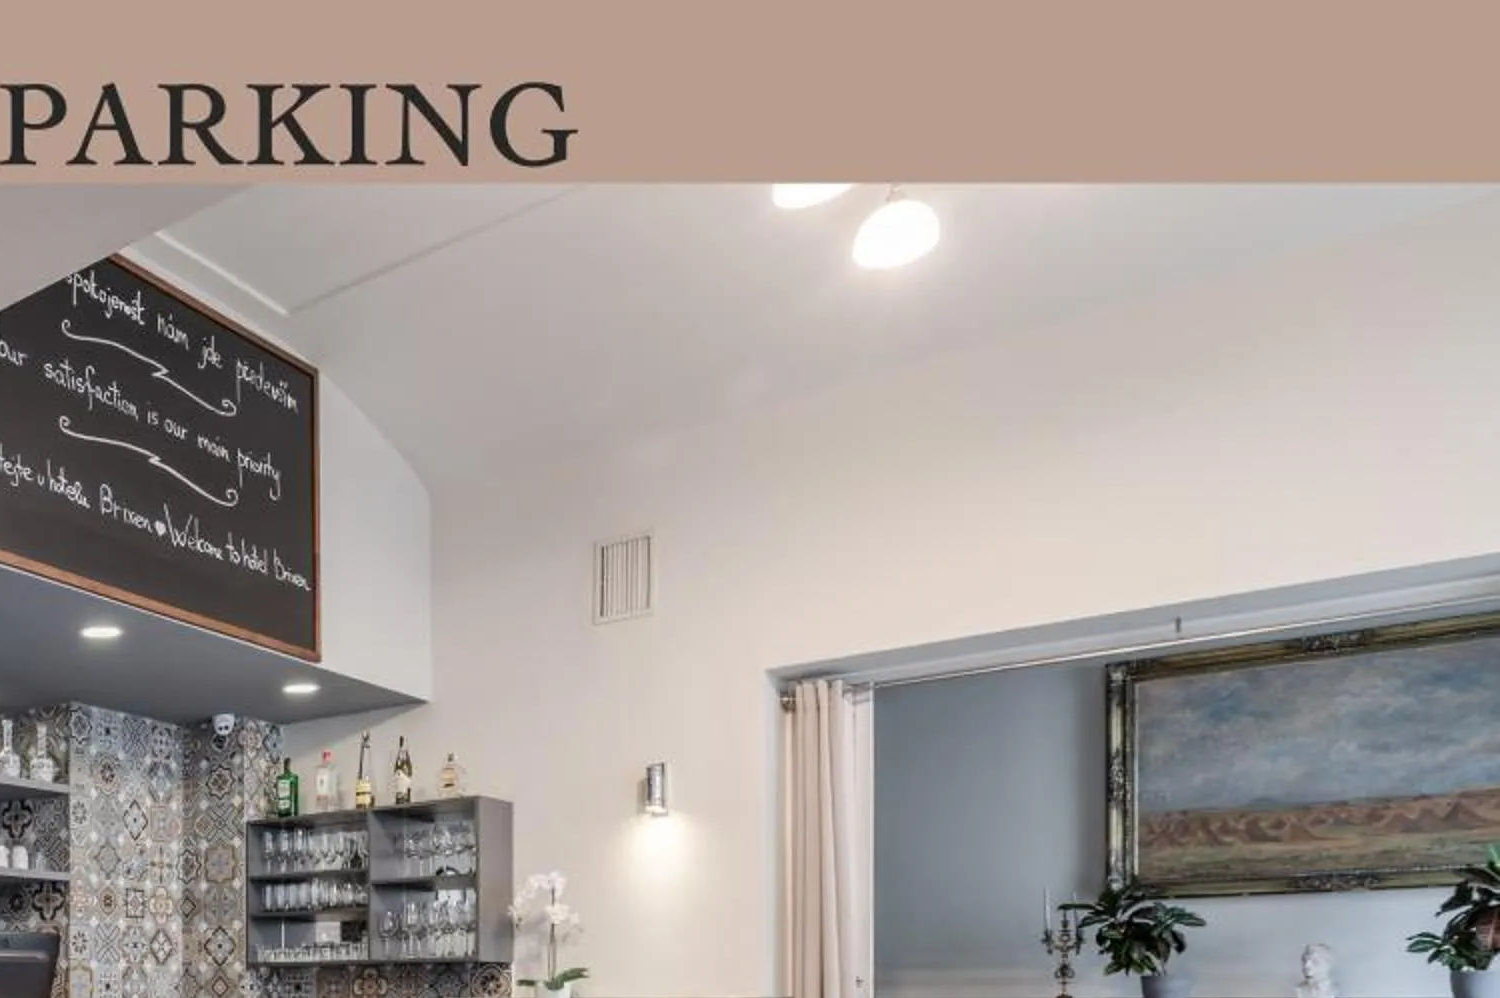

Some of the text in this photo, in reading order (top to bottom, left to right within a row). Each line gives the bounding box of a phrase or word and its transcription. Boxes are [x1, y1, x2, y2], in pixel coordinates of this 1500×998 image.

[44, 358, 139, 421] satisfaction
[147, 411, 159, 425] is
[164, 418, 188, 440] our
[237, 447, 282, 501] priority
[99, 483, 153, 533] Brixen
[163, 502, 224, 561] Welcome
[241, 537, 268, 575] hotel
